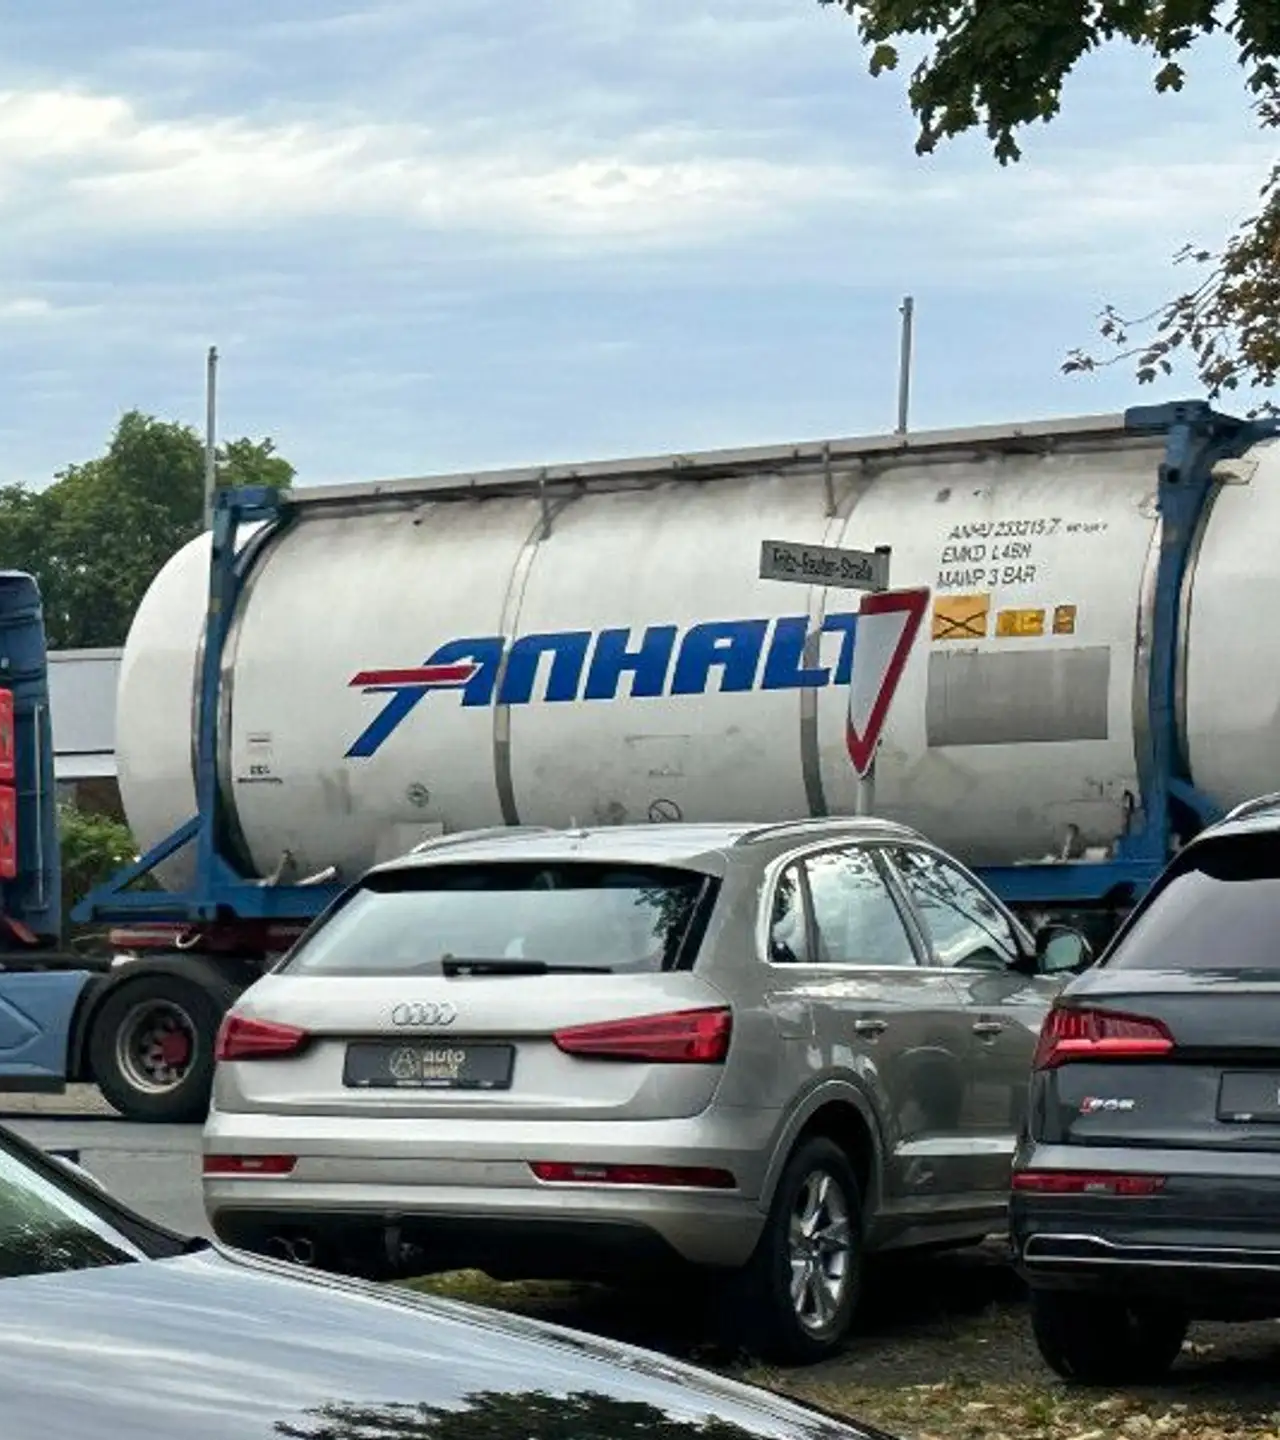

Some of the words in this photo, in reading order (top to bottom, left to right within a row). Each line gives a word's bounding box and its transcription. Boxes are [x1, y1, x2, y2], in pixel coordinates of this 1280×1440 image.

[1000, 565, 1037, 585] BAR
[344, 611, 858, 760] ANHALT
[423, 1048, 466, 1063] auto
